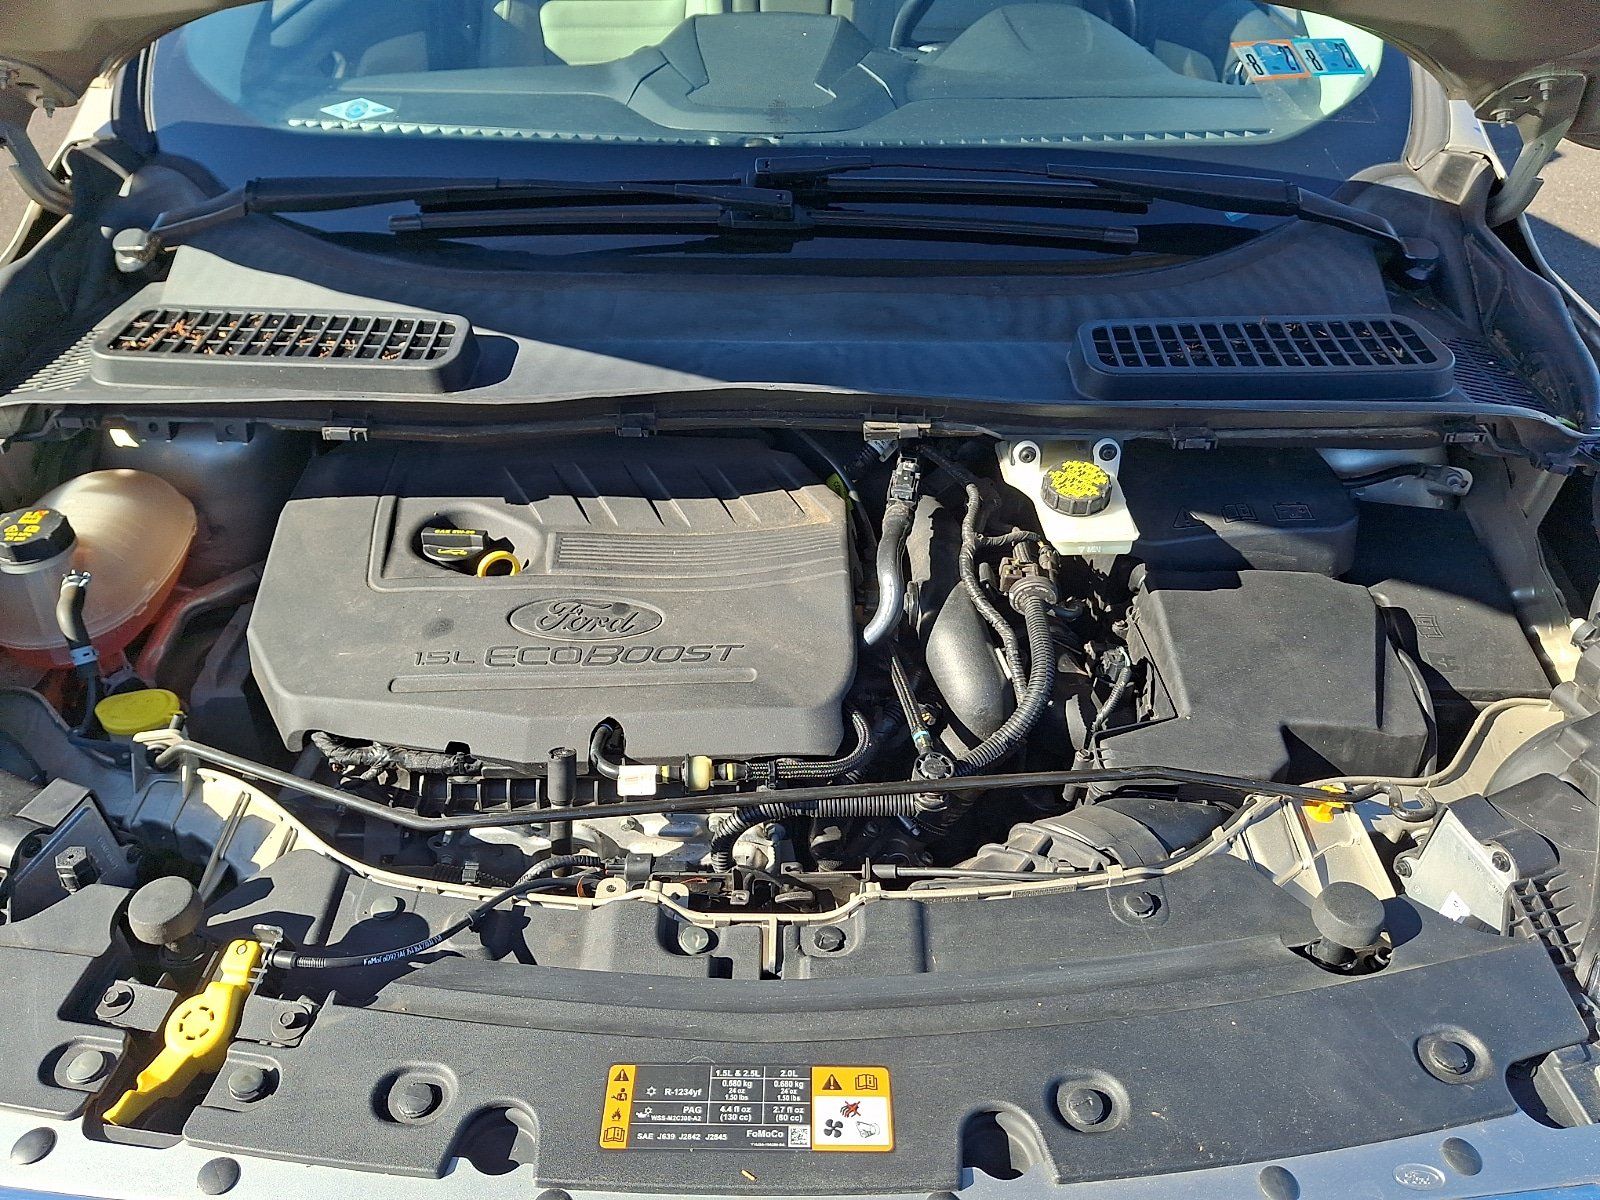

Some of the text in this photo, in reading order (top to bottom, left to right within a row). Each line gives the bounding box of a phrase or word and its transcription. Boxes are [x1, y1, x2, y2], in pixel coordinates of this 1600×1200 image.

[536, 600, 636, 634] Ford
[414, 644, 745, 668] 1.5L ECOBOOST
[743, 1080, 753, 1089] kg
[794, 1081, 804, 1089] kg
[664, 1088, 702, 1097] R-1234yf
[720, 1114, 752, 1122] (130 cc)
[678, 1133, 701, 1141] J2842
[746, 1130, 784, 1138] FoMoCo
